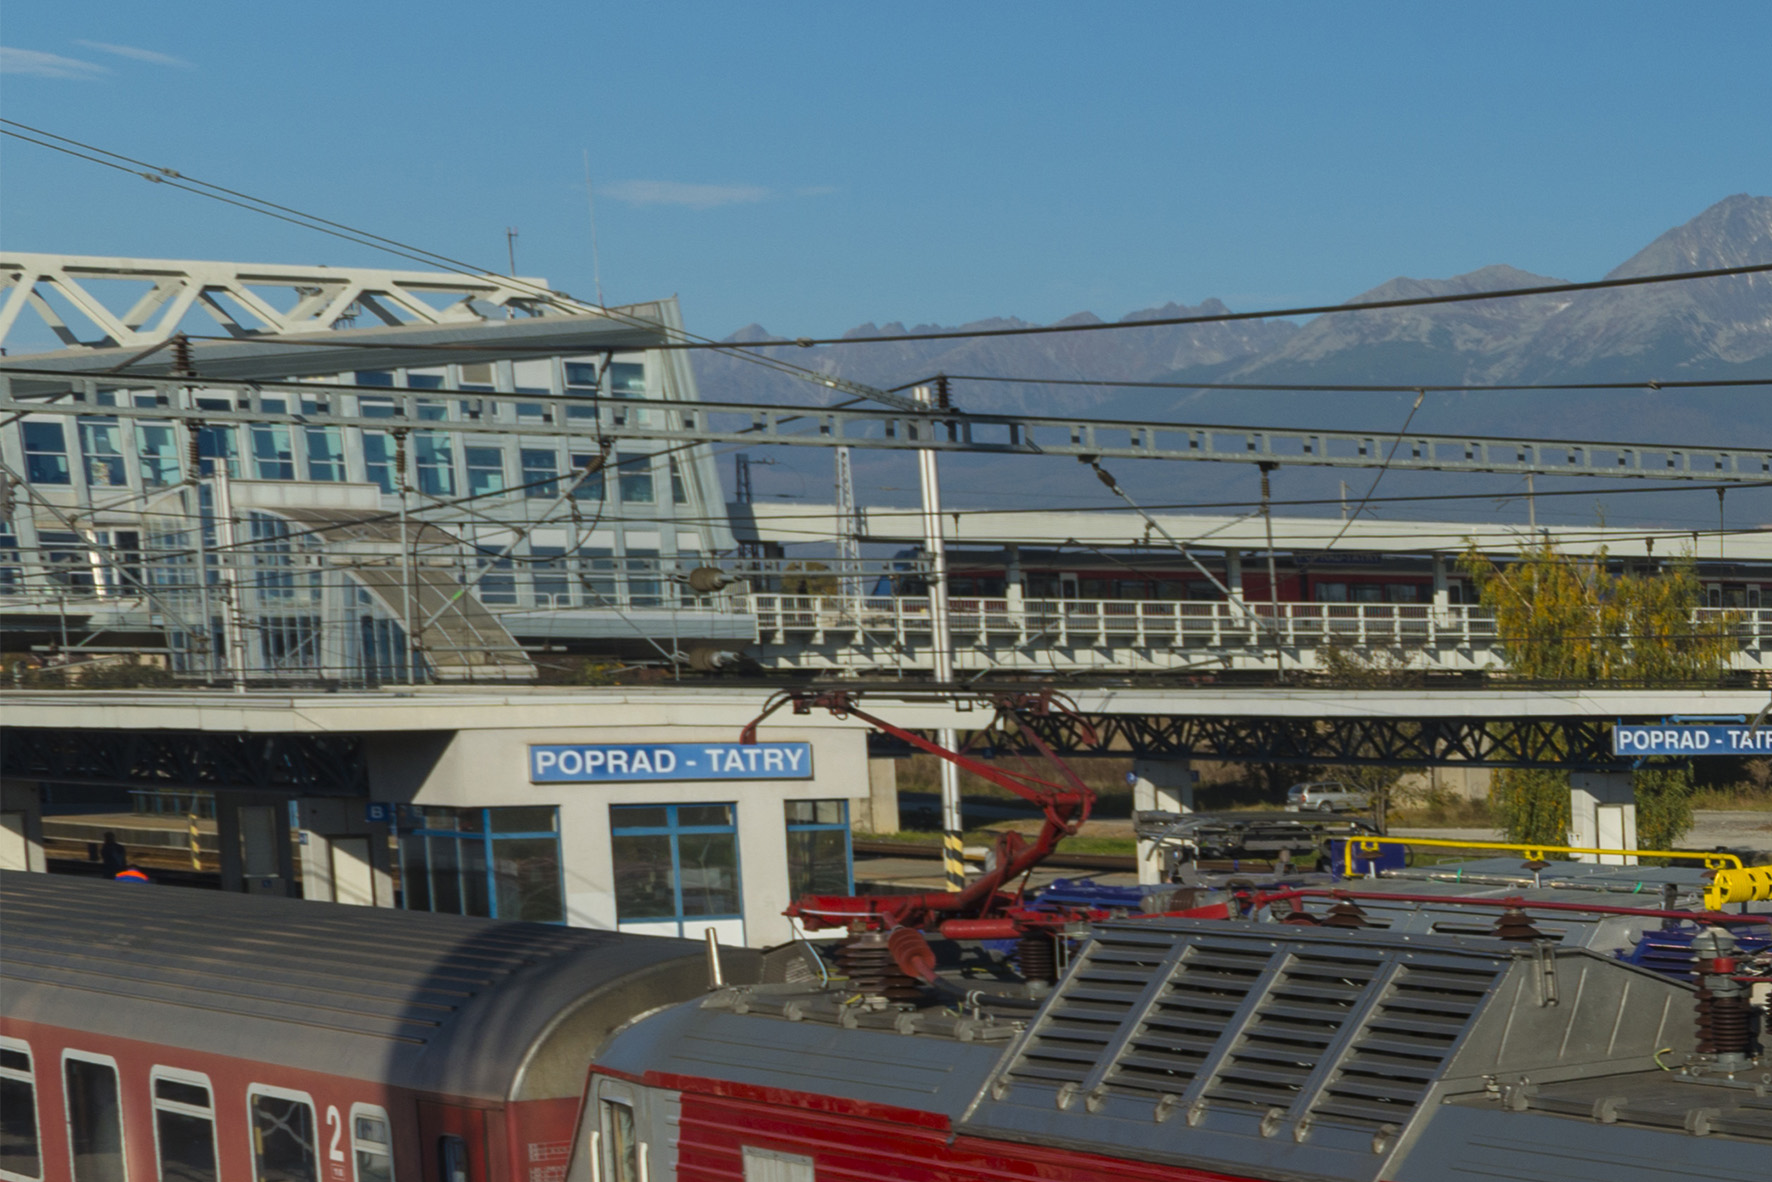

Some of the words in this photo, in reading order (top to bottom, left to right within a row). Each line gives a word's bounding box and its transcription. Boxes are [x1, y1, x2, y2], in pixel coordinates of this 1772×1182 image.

[1618, 730, 1710, 750] POPRAD
[535, 749, 677, 775] POPRAD
[705, 747, 805, 773] TATRY
[326, 1104, 345, 1162] 2
